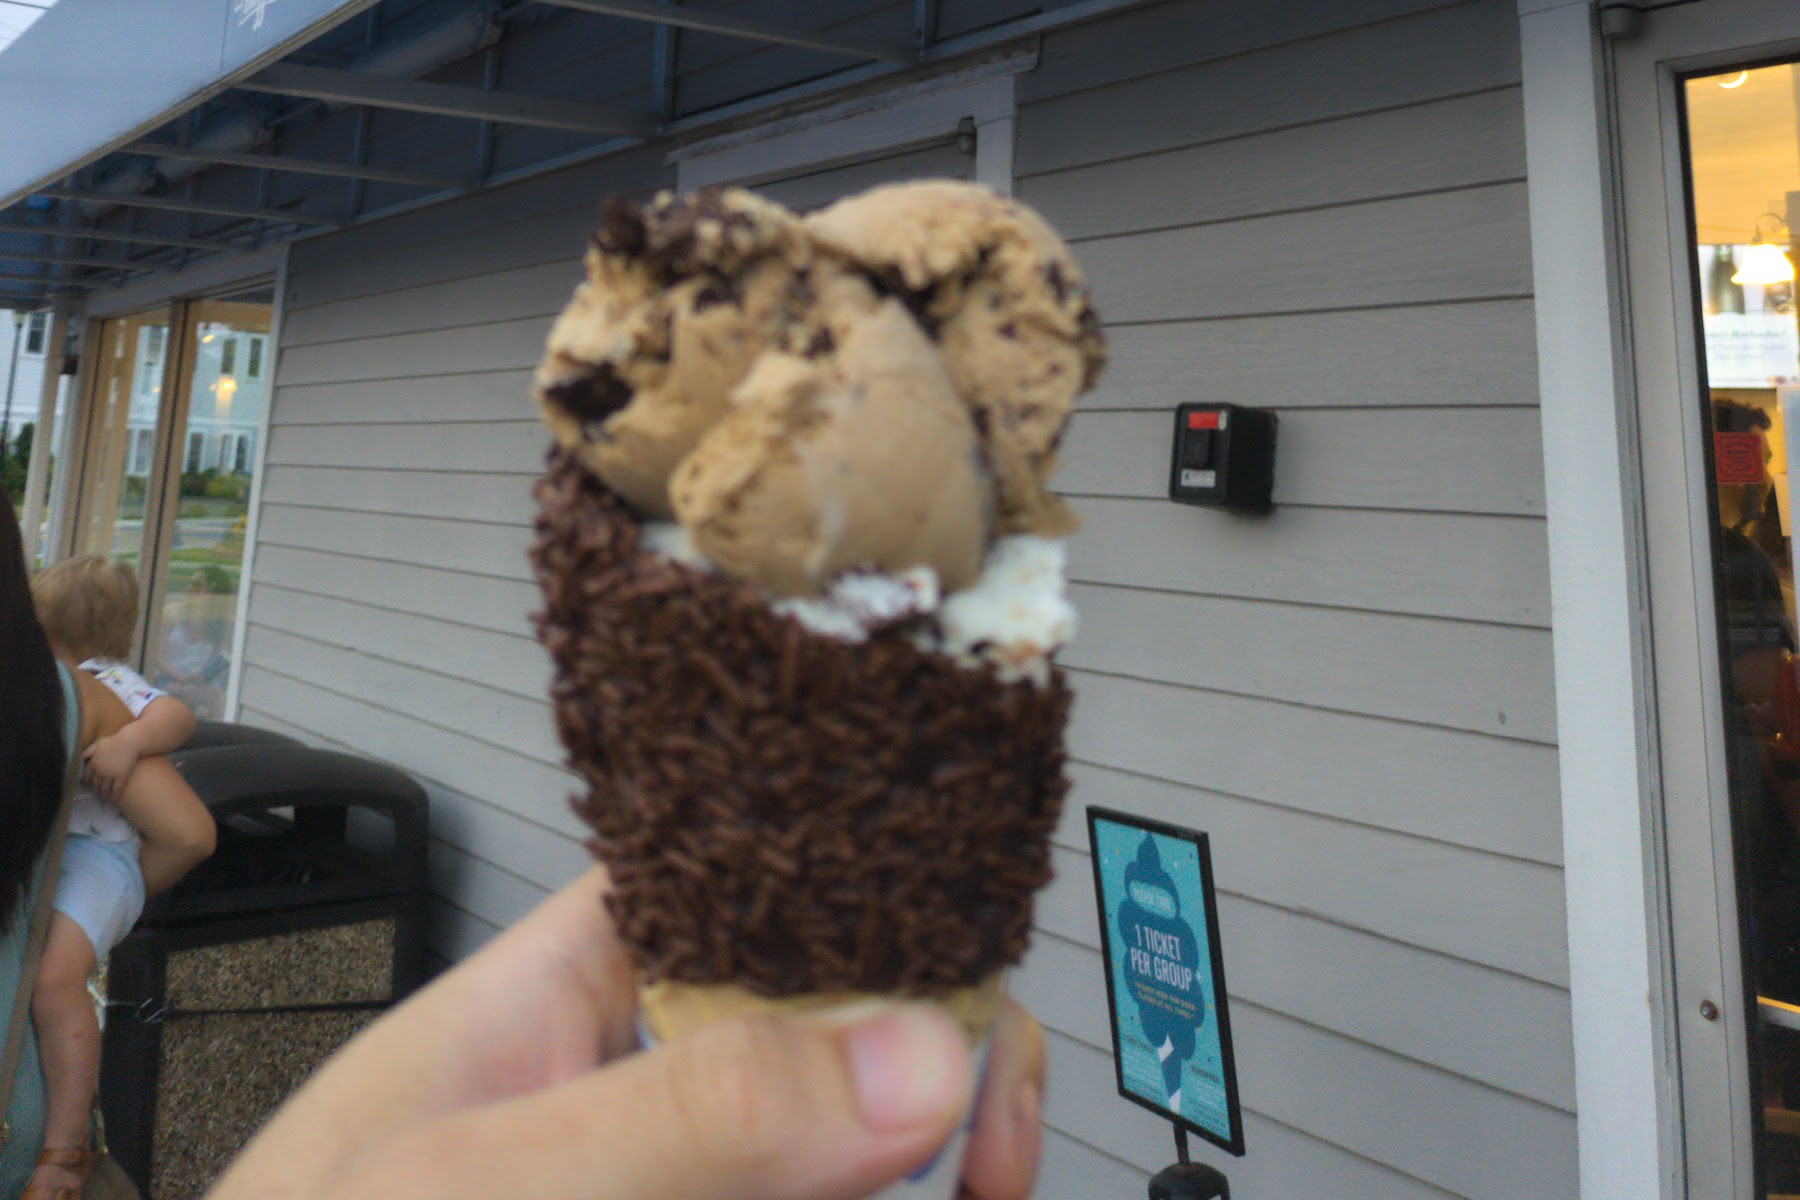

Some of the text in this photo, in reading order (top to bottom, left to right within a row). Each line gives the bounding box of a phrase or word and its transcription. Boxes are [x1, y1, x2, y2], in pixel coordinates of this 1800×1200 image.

[1135, 923, 1180, 961] 1 TICKET
[1130, 947, 1192, 991] PER GROUP
